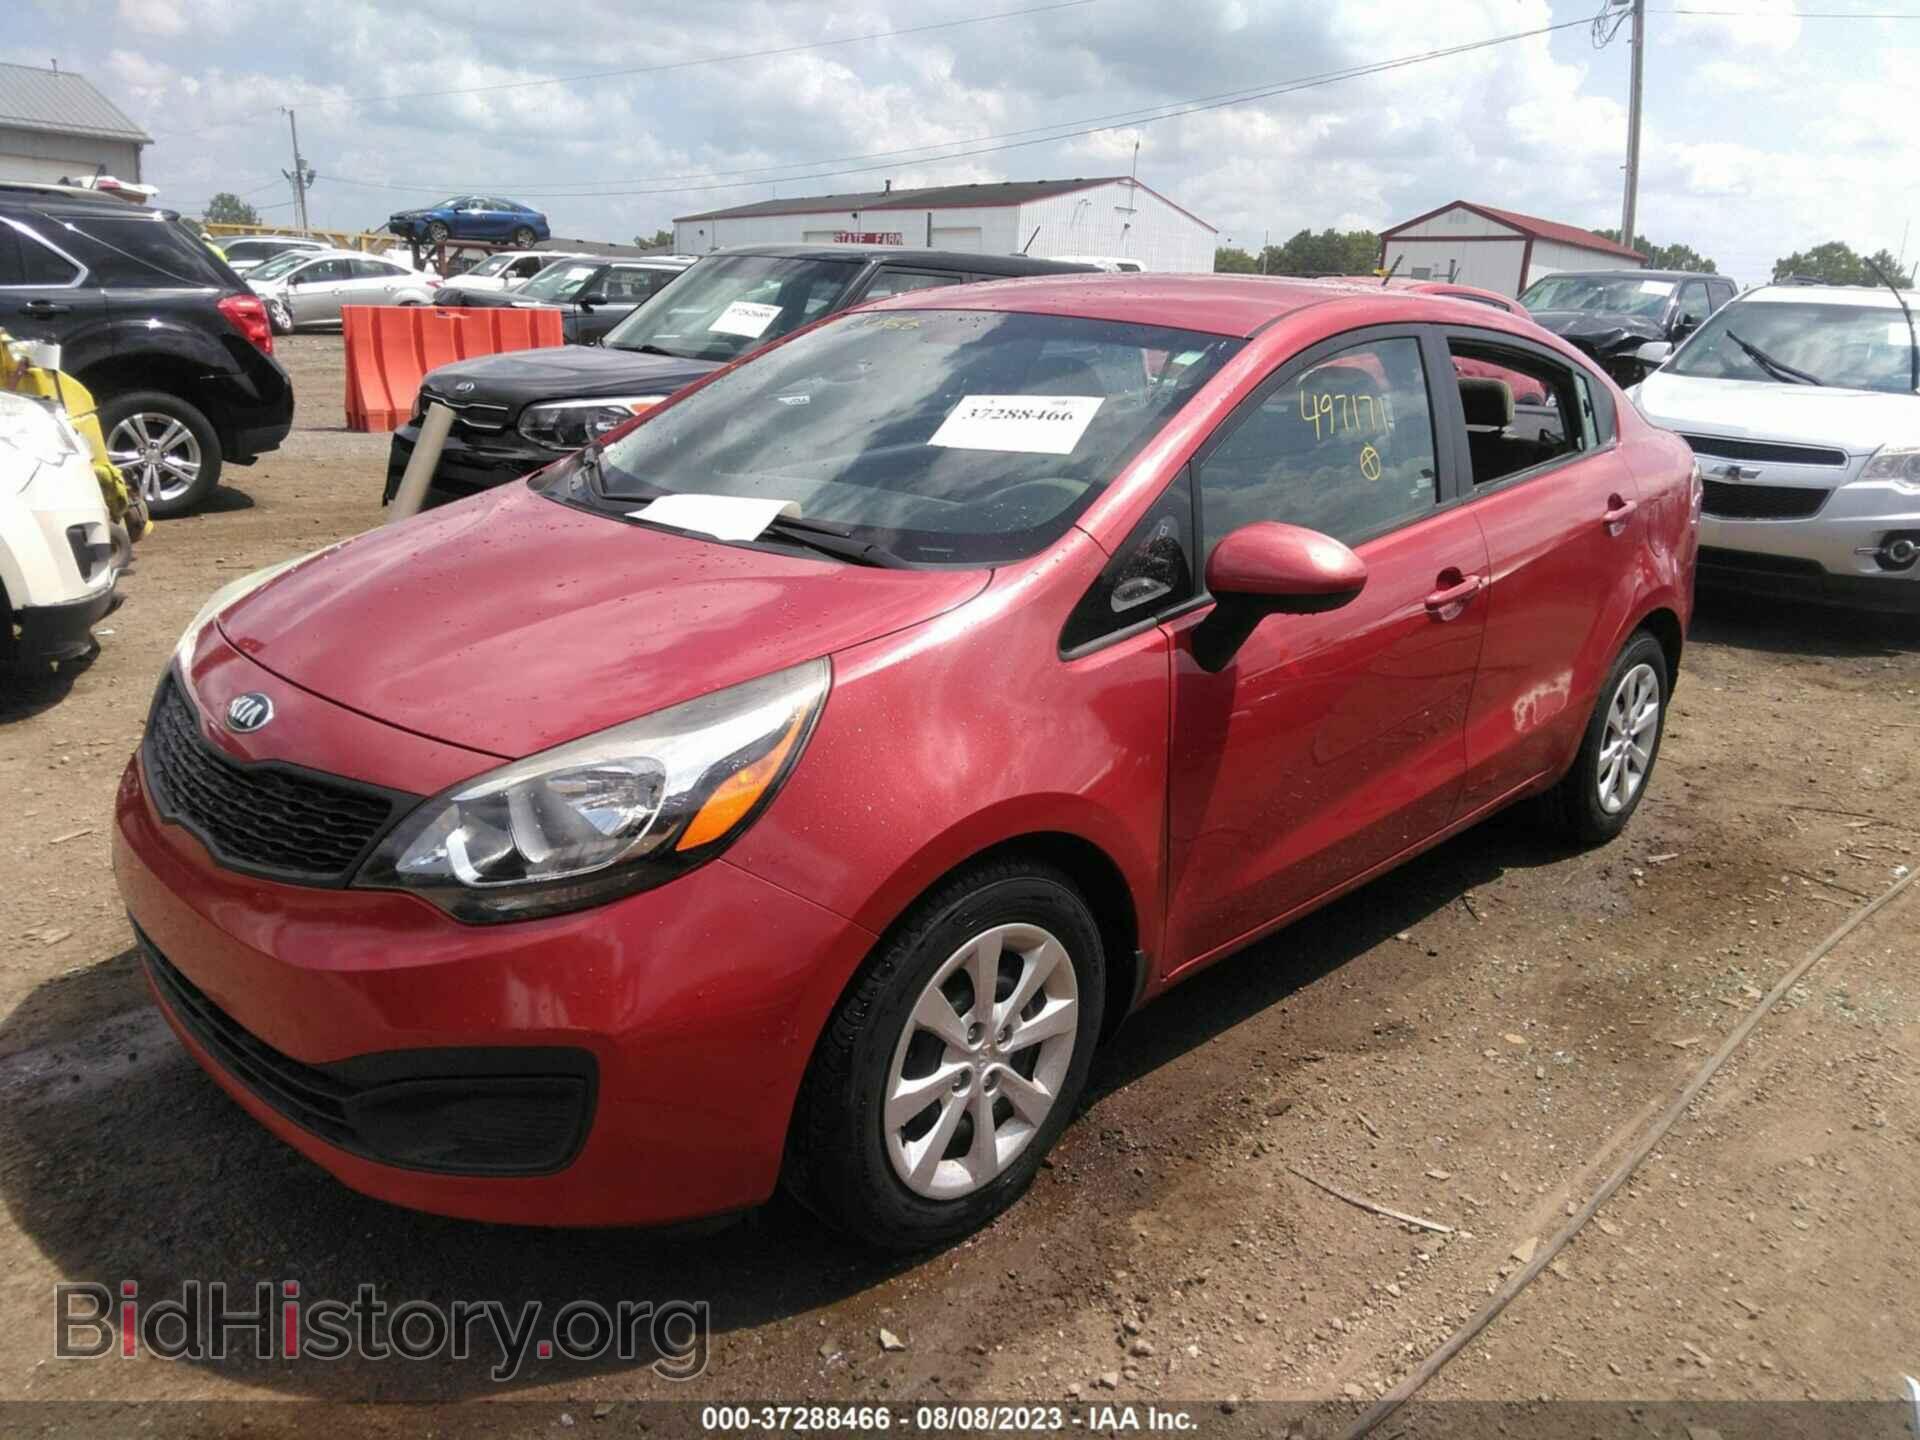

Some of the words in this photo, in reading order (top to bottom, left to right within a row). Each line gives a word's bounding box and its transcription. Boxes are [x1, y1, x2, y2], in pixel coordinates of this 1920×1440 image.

[832, 231, 866, 245] STATE
[961, 407, 1073, 422] 37288466
[230, 696, 264, 727] KIA
